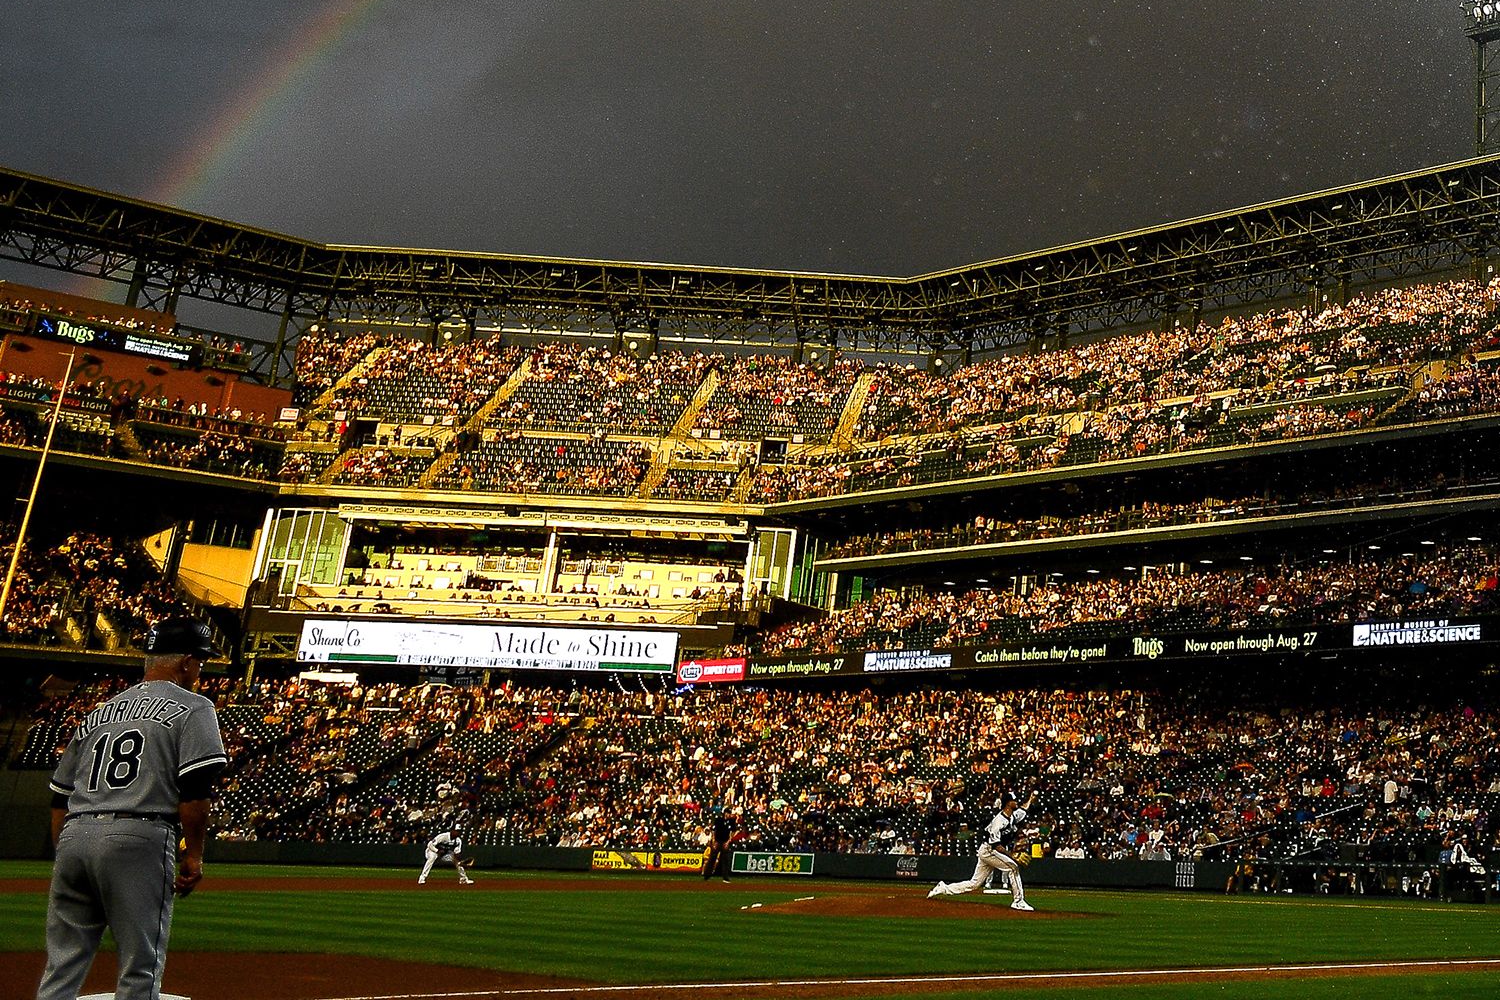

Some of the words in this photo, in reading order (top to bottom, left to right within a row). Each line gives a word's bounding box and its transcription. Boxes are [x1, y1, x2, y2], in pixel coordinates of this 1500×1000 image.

[57, 319, 96, 344] Bugs
[8, 389, 37, 400] LIGHT
[81, 400, 108, 412] LIGHT
[1439, 619, 1449, 628] OF
[308, 627, 344, 647] Shane
[491, 631, 560, 655] Made
[567, 641, 580, 653] to
[586, 633, 658, 659] Shine
[1185, 639, 1209, 653] Now
[1210, 638, 1235, 654] open
[1237, 633, 1275, 652] through
[1276, 633, 1301, 651] Aug.
[1303, 631, 1318, 646] 27
[975, 649, 998, 664] Catch
[1000, 648, 1020, 663] them
[1021, 647, 1049, 662] before
[1050, 645, 1079, 661] they're
[1081, 643, 1107, 660] gone!
[1132, 636, 1164, 660] Bugs
[751, 663, 768, 675] Now
[768, 665, 786, 676] open
[787, 660, 813, 675] through
[814, 661, 832, 674] Aug.
[833, 658, 844, 671] 27
[77, 696, 191, 741] RODRIGUEZ
[87, 728, 145, 792] 18
[663, 857, 686, 865] DENVER
[746, 854, 801, 873] bet365
